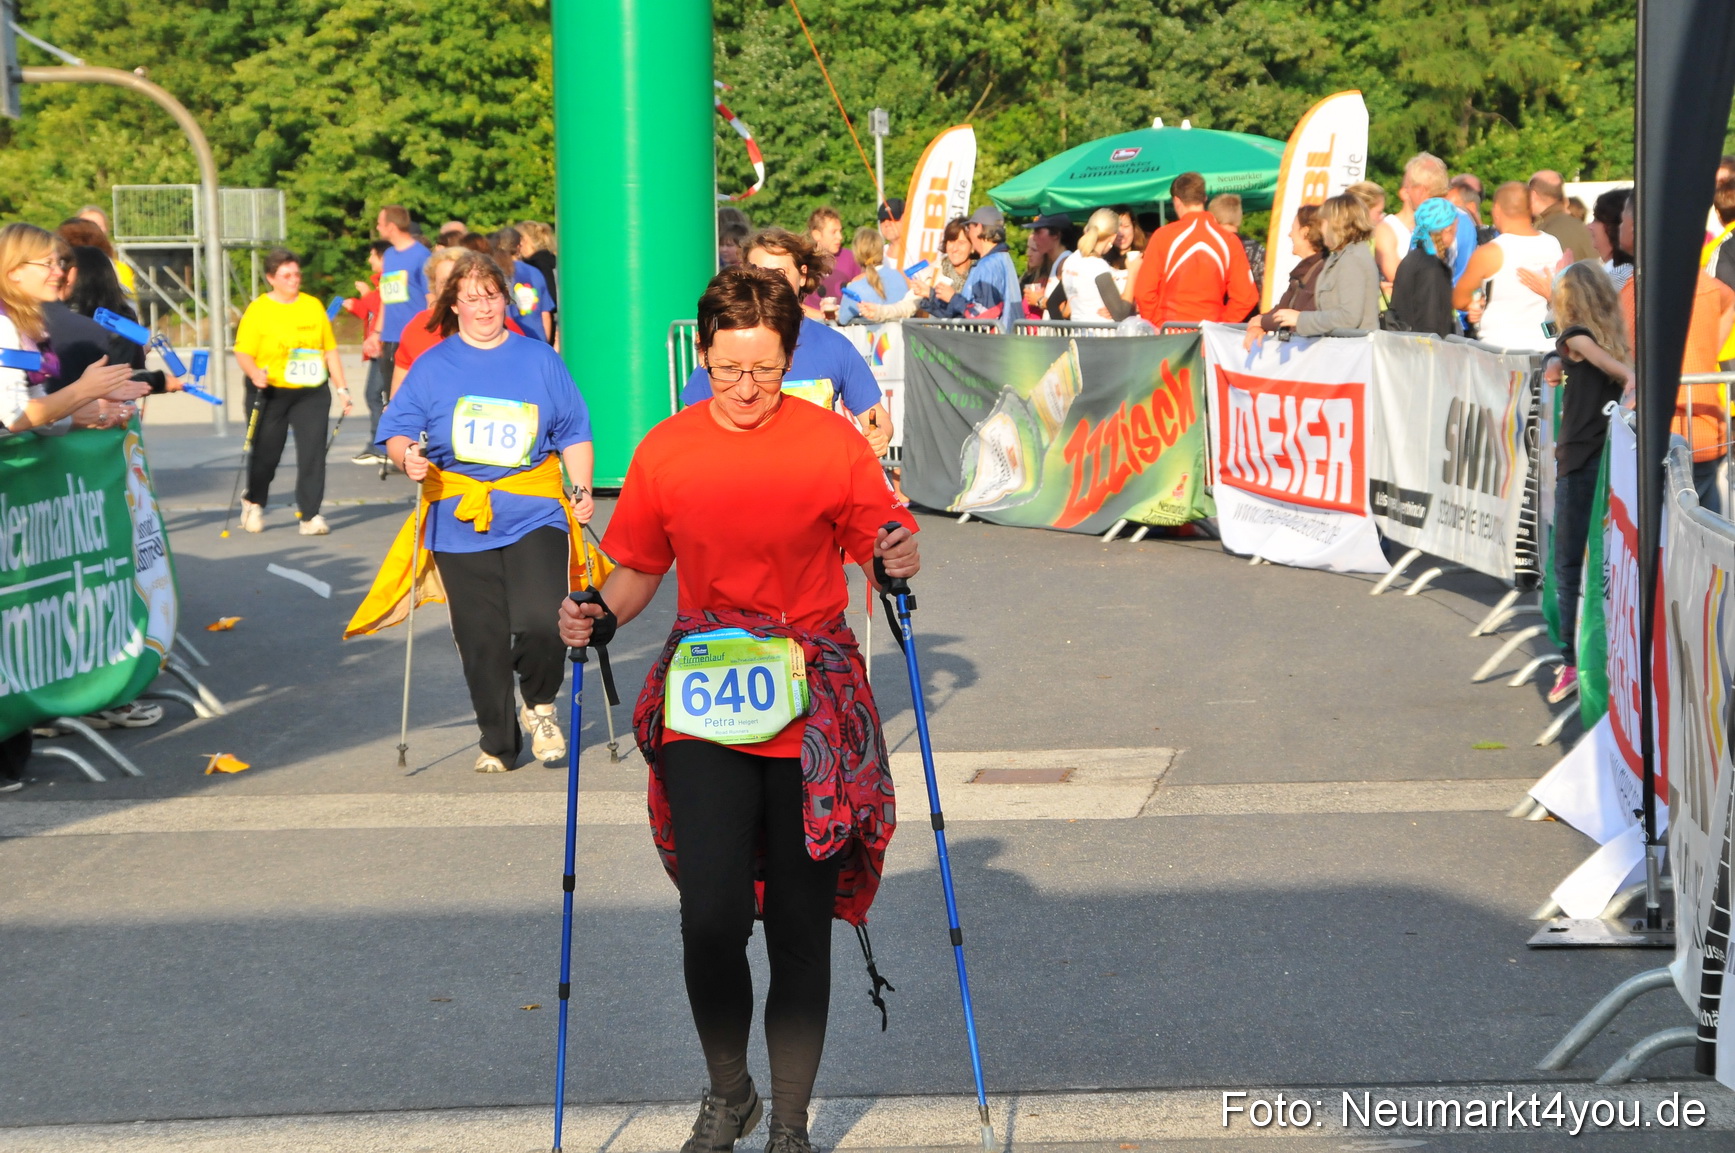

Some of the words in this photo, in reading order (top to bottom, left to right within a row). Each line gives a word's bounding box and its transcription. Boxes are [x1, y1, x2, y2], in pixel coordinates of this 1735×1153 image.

[1069, 165, 1161, 180] Lammsbräu
[1300, 132, 1336, 206] BL
[1216, 172, 1264, 183] Neumarkter
[289, 361, 319, 376] 210
[464, 419, 518, 449] 118
[1227, 383, 1354, 504] MEIER
[683, 652, 725, 664] firmenlauf
[681, 665, 776, 717] 640
[704, 718, 735, 728] Petra
